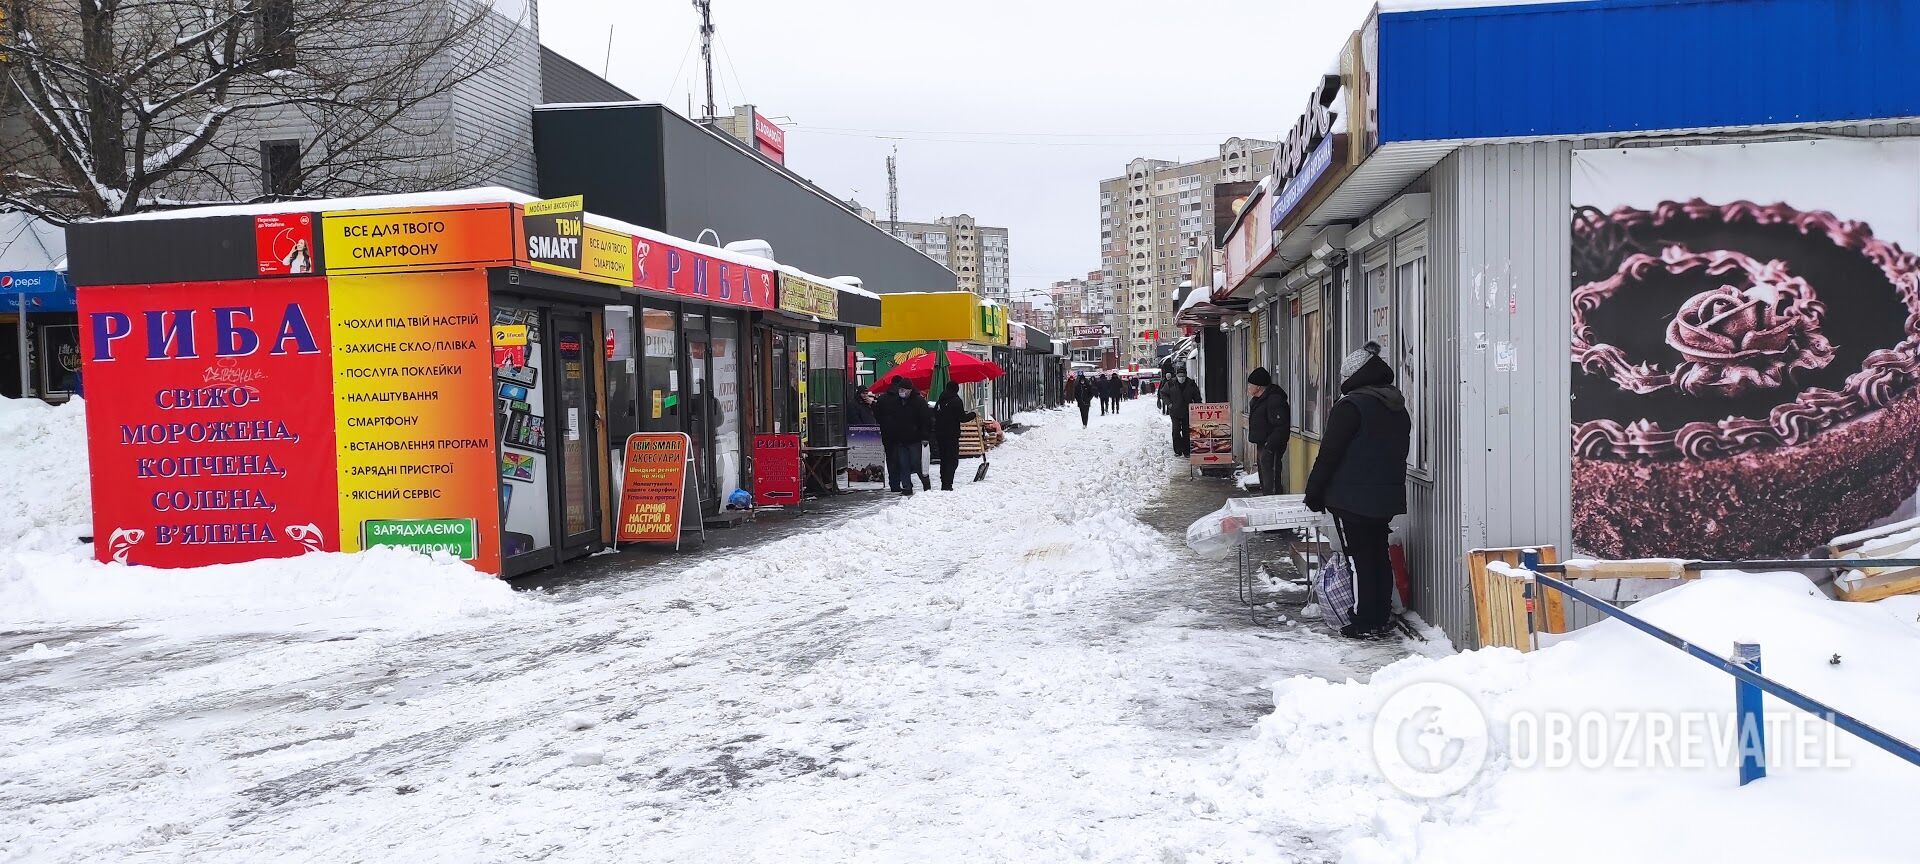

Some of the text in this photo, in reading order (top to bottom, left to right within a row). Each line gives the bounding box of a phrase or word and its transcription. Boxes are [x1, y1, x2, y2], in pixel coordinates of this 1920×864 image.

[529, 199, 579, 213] мобільні аксесуари
[343, 221, 445, 238] ВСЕ ДЛЯ ТВОГО
[555, 216, 581, 236] ТВІЙ
[352, 243, 439, 259] СМАРТФОНУ
[529, 235, 578, 259] SMART
[590, 237, 628, 255] ВСЕ ДЛЯ ТВОГО
[593, 257, 626, 272] СМАРТФОНУ
[14, 276, 41, 288] pepsi
[666, 249, 754, 304] РИБА
[343, 313, 479, 329] ЧОХЛИ ПІД ТВІЙ НАСТРІЙ
[1373, 306, 1389, 328] ТОРТ
[90, 303, 321, 362] РИБА
[345, 340, 477, 354] ЗАХИСНЕ СКЛО/ПЛІВКА
[63, 355, 81, 368] Coffe
[346, 365, 462, 378] ПОСЛУГА ПОКЛЕЙКИ
[155, 386, 260, 410] СВІЖО-
[347, 390, 439, 402] НАЛАШТУВАННЯ
[347, 415, 419, 427] СМАРТФОНУ
[1197, 410, 1222, 419] ТУТ
[120, 419, 300, 445] МОРОЖЕНА,
[350, 438, 489, 451] ВСТАНОВЛЕННЯ ПРОГРАМ
[632, 440, 681, 451] ТВІЙ SMART
[632, 453, 680, 463] АКСЕСУАРИ
[136, 454, 288, 479] КОПЧЕНА,
[351, 462, 454, 477] ЗАРЯДНІ ПРИСТРОЇ
[151, 488, 277, 513] СОЛЕНА,
[351, 488, 441, 500] ЯКІСНИЙ СЕРВІС
[635, 502, 667, 514] ГАРНИЙ
[628, 512, 671, 523] НАСТРІЙ В
[373, 523, 465, 536] ЗАРЯДЖАЄМО
[624, 523, 672, 534] ПОДАРУНОК
